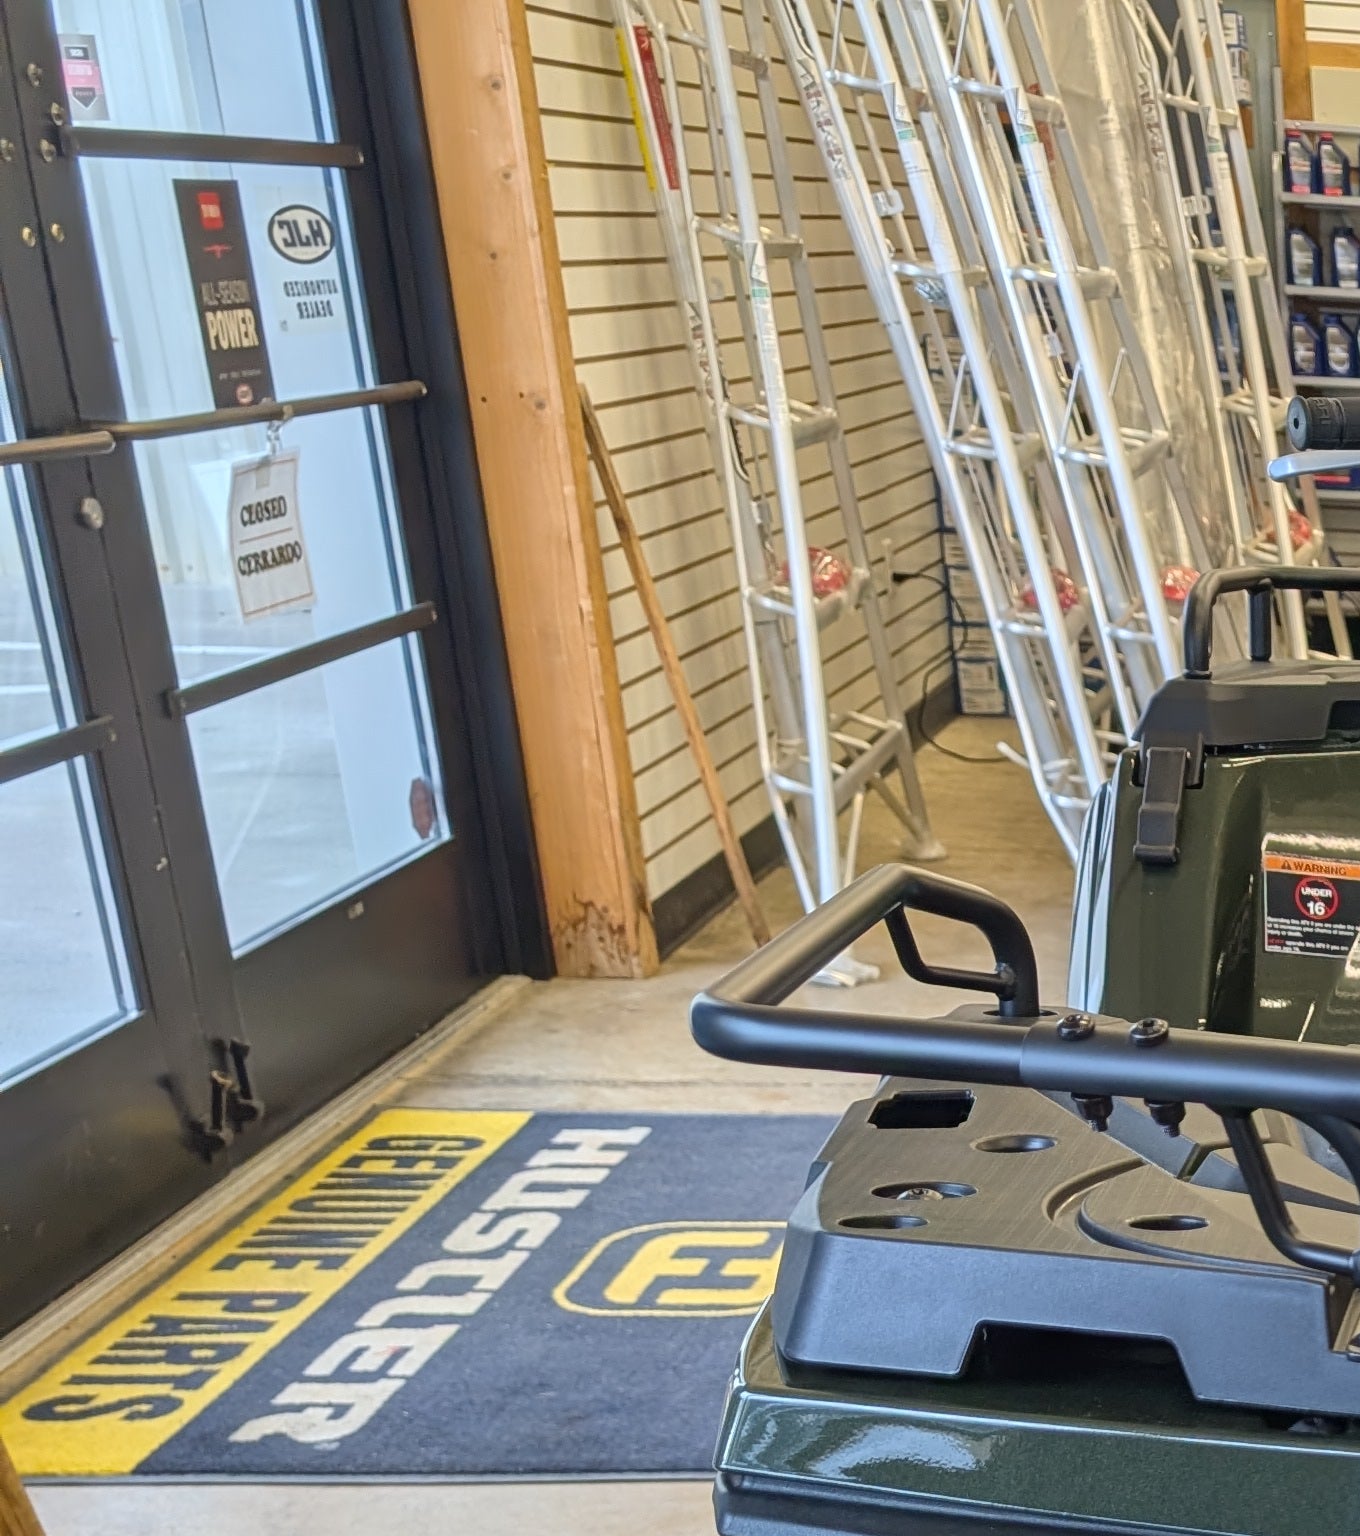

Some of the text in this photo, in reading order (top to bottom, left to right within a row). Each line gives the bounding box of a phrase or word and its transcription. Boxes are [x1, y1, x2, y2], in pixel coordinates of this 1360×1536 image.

[205, 308, 259, 351] POWER
[240, 495, 287, 527] CLOSED
[1293, 861, 1346, 876] WARNING
[1301, 887, 1332, 898] UNDER
[1306, 901, 1326, 916] 16
[212, 1133, 488, 1274] GENUINE
[228, 1125, 654, 1448] HUSTLER
[20, 1289, 300, 1424] PARTS
